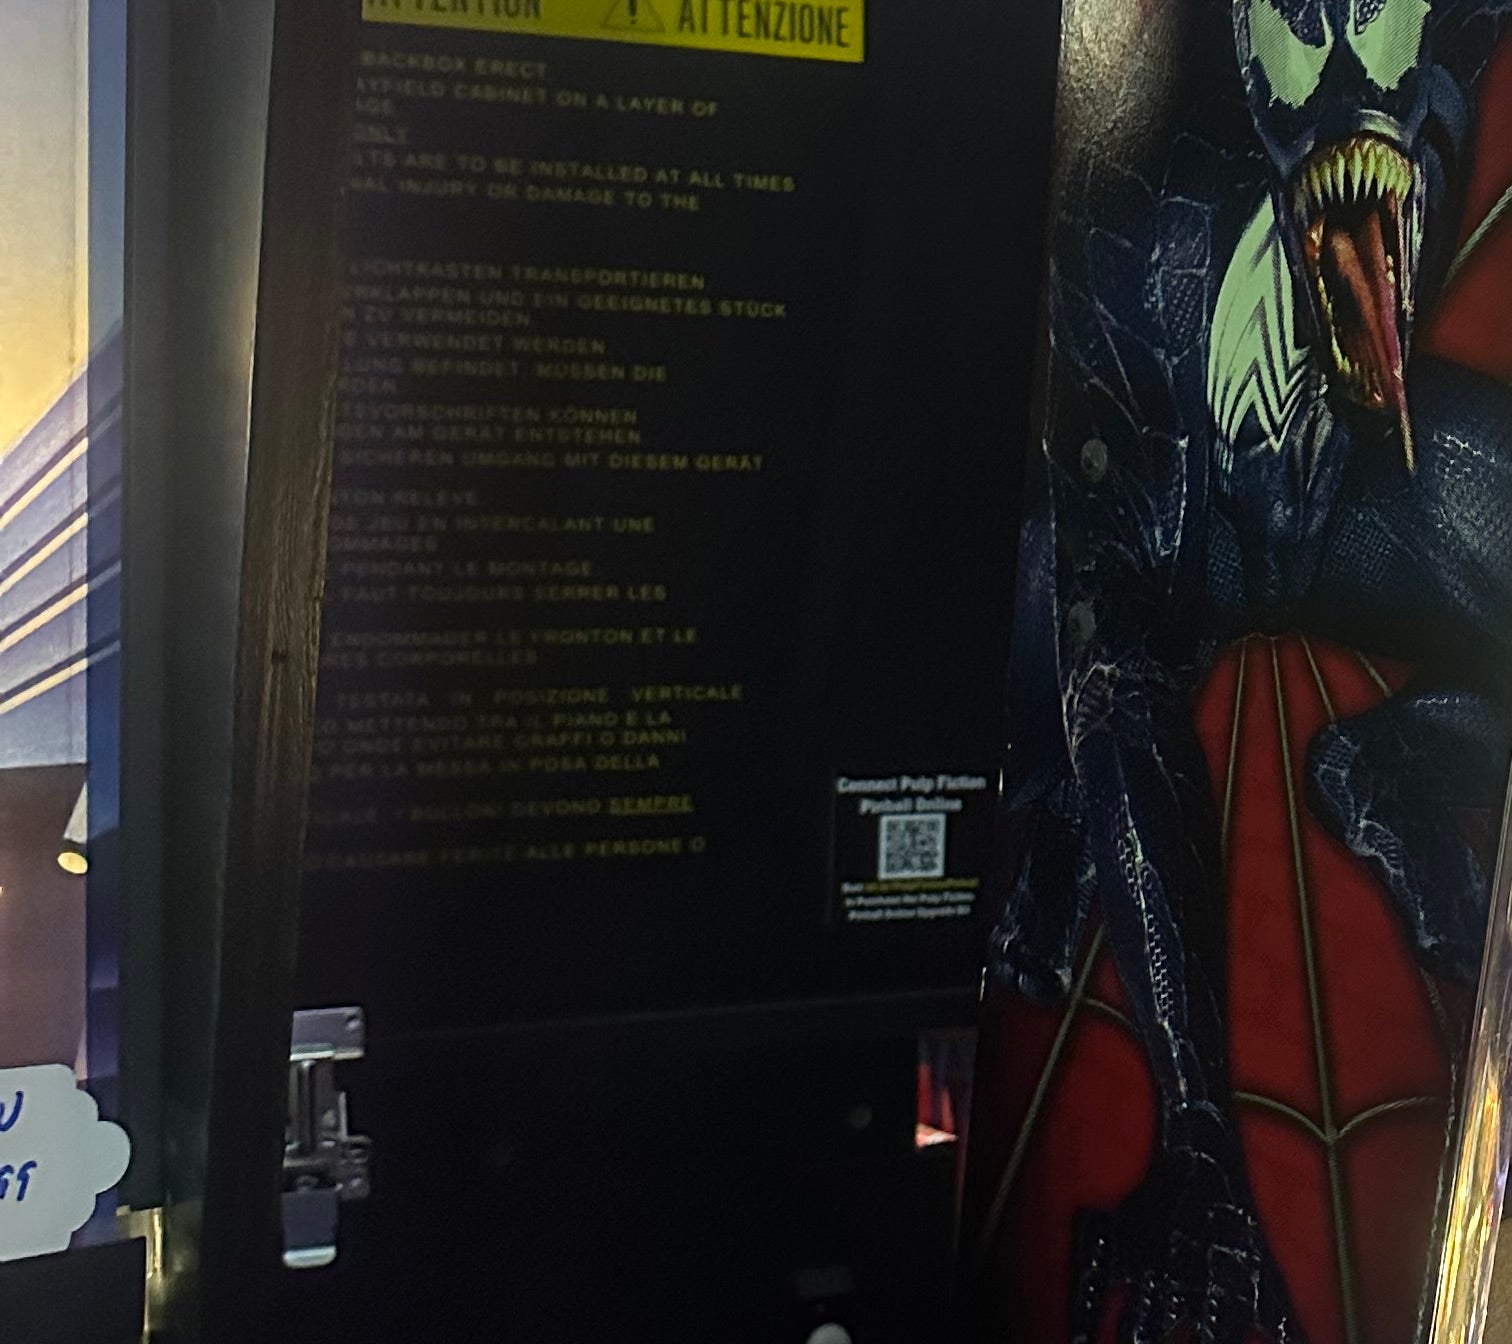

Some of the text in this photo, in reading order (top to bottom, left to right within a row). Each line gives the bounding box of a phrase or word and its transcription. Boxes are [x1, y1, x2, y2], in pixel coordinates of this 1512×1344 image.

[361, 51, 547, 80] BACKBOX ERECT
[453, 83, 547, 105] CABINET
[556, 89, 587, 108] ON
[596, 93, 609, 109] A
[616, 95, 684, 116] LAYER
[691, 101, 719, 117] OF
[405, 153, 446, 171] ARE
[456, 154, 487, 172] TO
[494, 157, 522, 175] BE
[531, 160, 648, 182] INSTALLED
[656, 168, 681, 184] AT
[689, 169, 725, 188] ALL
[733, 173, 796, 192] TIMES
[399, 179, 477, 196] INJURY
[487, 182, 517, 199] OR
[526, 184, 615, 206] DAMAGE
[625, 191, 653, 208] TO
[661, 194, 700, 211] THE
[510, 265, 705, 290] TRANSPORTIEREN
[578, 294, 711, 316] GEEIGNETES
[633, 366, 667, 382] DIE
[565, 452, 599, 468] MIT
[608, 453, 688, 470] DIESEM
[612, 516, 656, 533] UNE
[487, 560, 592, 576] MONTAGE
[627, 584, 667, 601] LES
[640, 627, 665, 644] ET
[674, 627, 698, 644] LE
[493, 687, 610, 706] POSIZIONE
[631, 684, 744, 703] VERTICALE
[552, 711, 618, 728] PIANO
[625, 710, 638, 725] E
[646, 709, 672, 726] LA
[599, 731, 615, 746] O
[623, 729, 687, 745] DANNI
[594, 753, 660, 771] DELLA
[900, 775, 935, 794] Pulp
[937, 774, 987, 790] Fiction
[608, 795, 694, 816] SEMPRE
[585, 837, 682, 856] PERSONE
[689, 836, 706, 853] O
